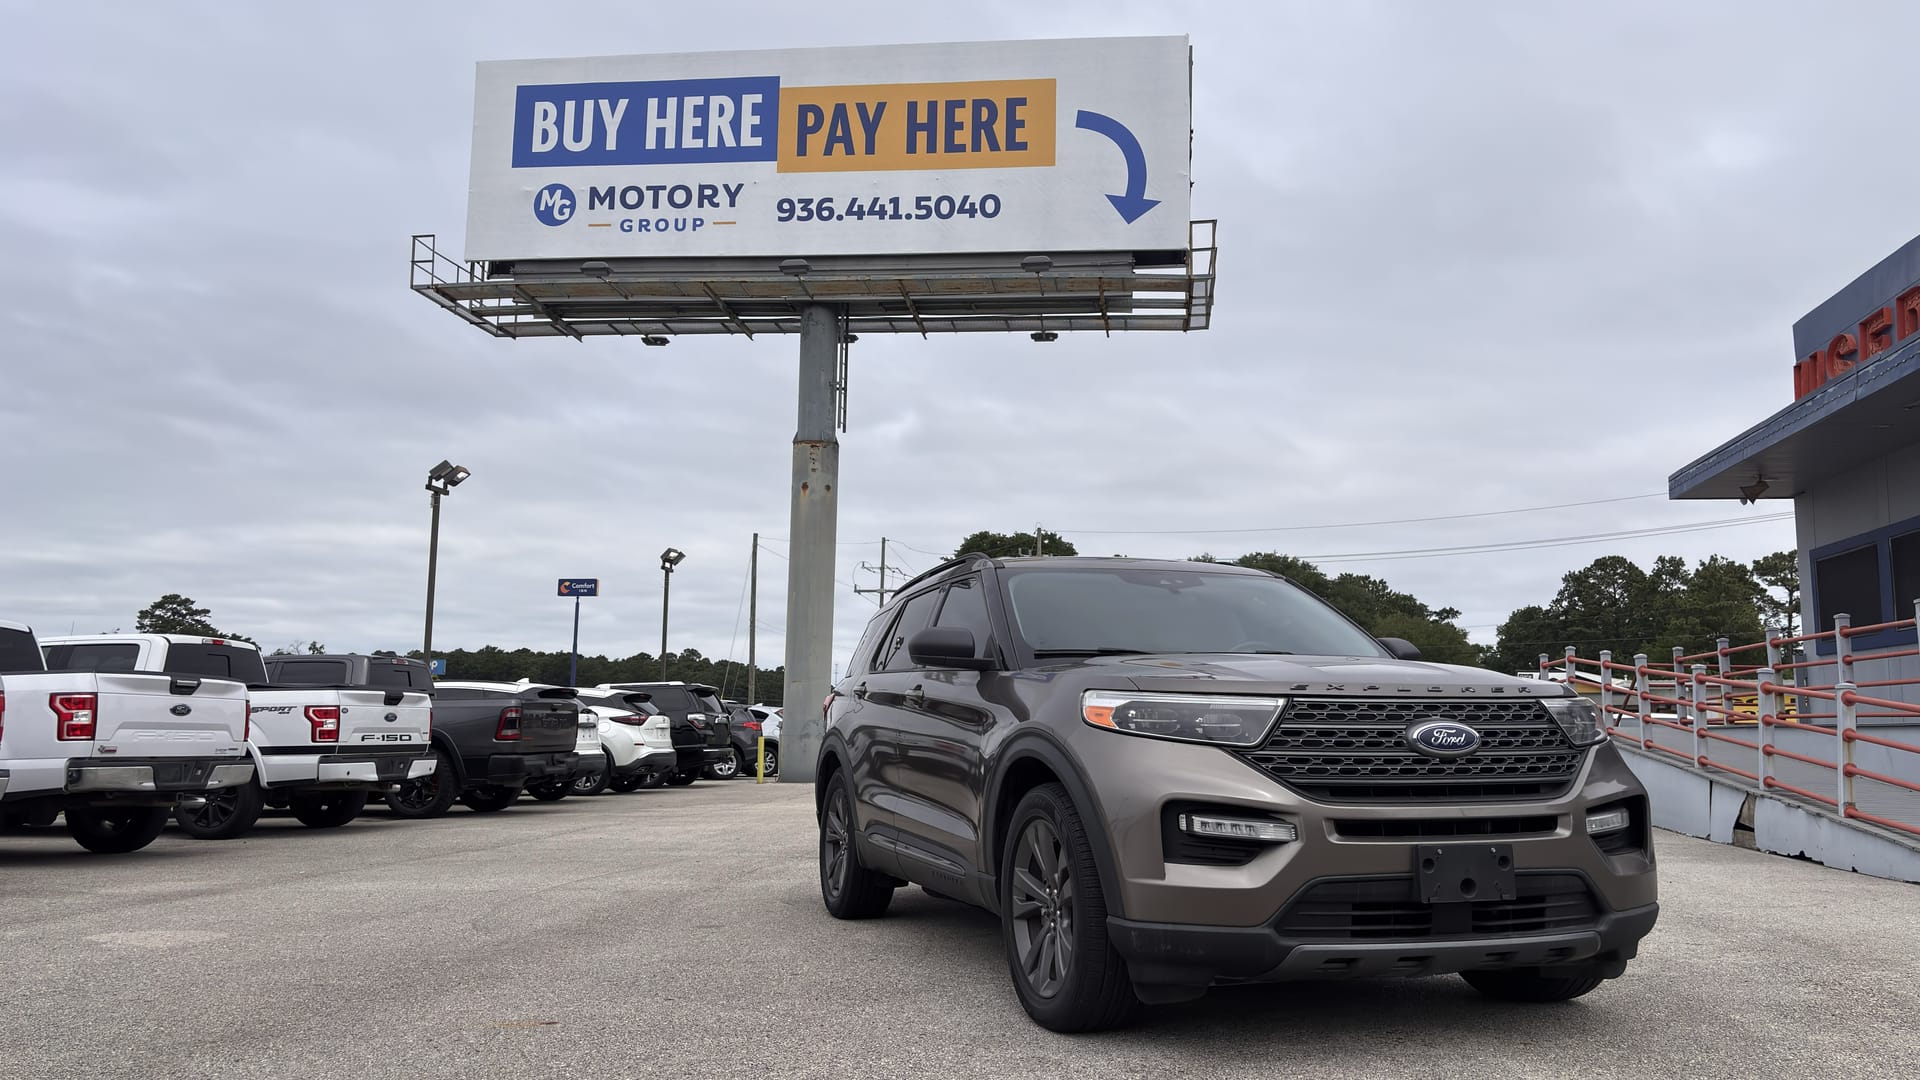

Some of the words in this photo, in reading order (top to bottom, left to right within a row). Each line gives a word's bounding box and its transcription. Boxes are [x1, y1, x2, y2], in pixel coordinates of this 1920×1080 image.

[531, 98, 629, 153] BUY
[645, 93, 763, 150] HERE
[796, 101, 887, 157] PAY
[906, 97, 1028, 154] HERE
[539, 190, 571, 220] MG
[588, 183, 744, 211] MOTORY
[776, 194, 1001, 222] 936.441.5040
[619, 218, 705, 233] GROUP
[1290, 684, 1531, 693] EXPLORER
[361, 734, 412, 742] F-150
[1431, 728, 1466, 746] Ford
